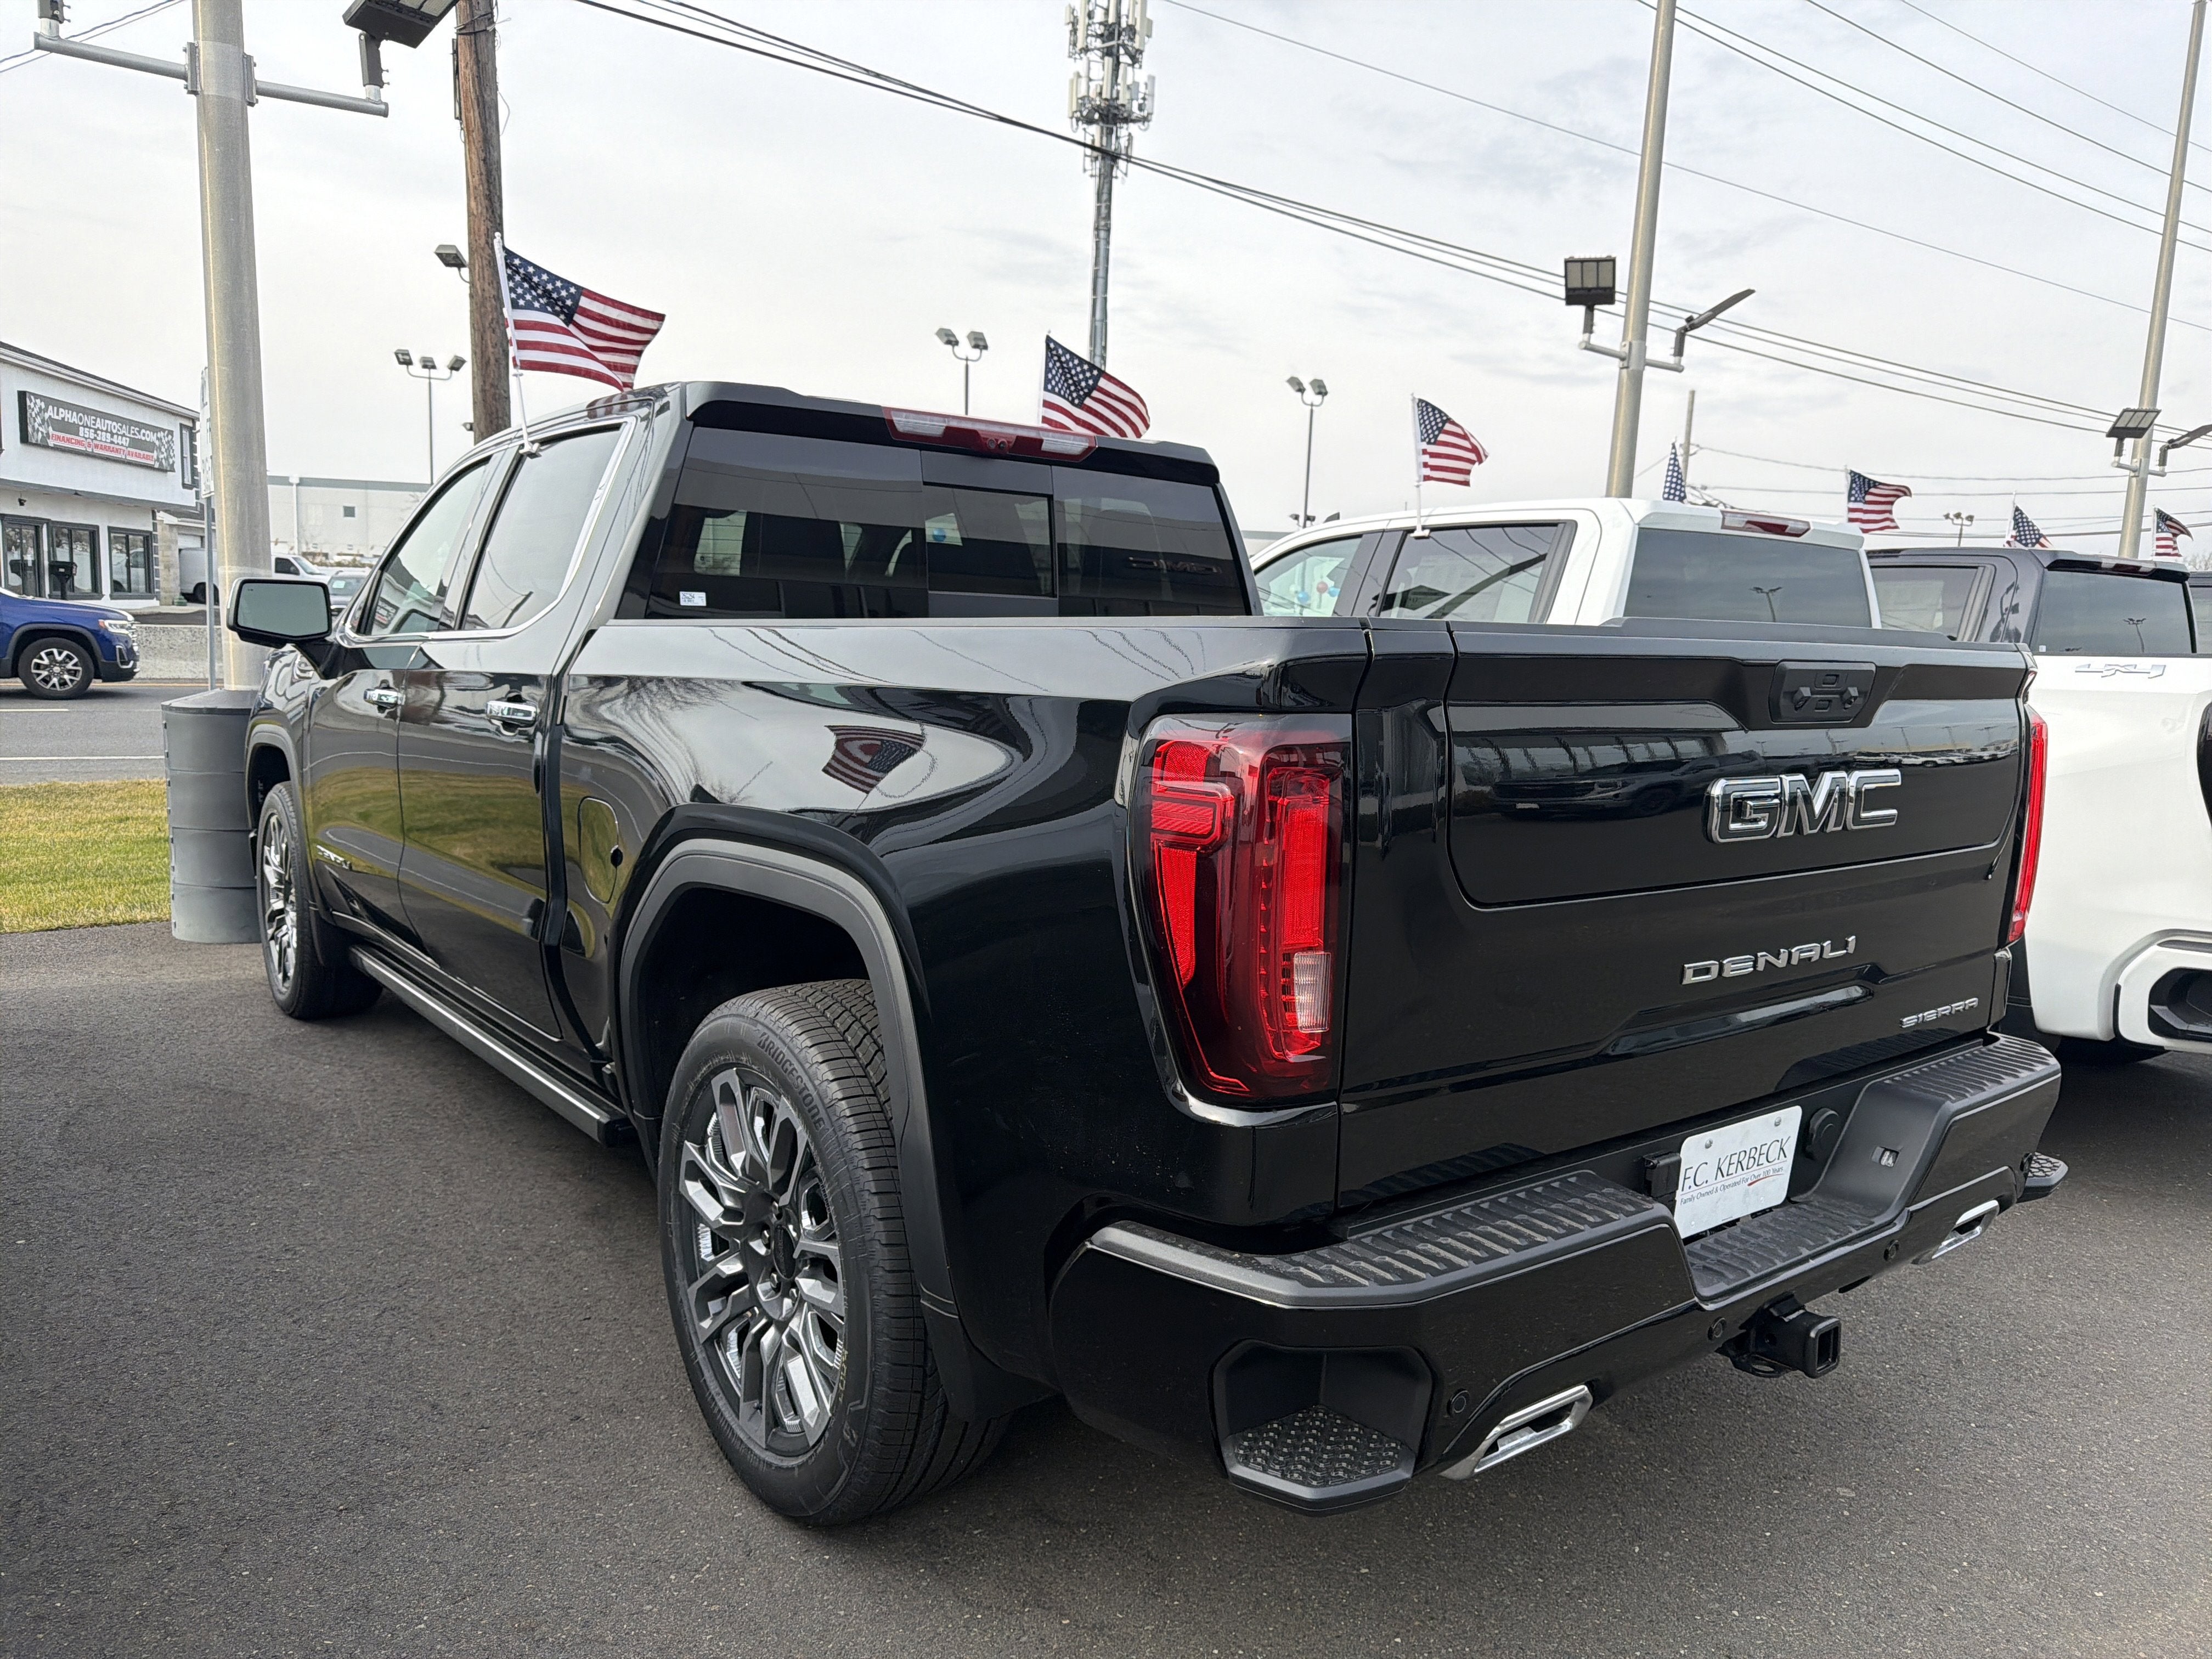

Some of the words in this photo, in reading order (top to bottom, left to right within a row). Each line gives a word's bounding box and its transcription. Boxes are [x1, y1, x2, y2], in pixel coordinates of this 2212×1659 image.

[47, 405, 157, 442] ALPHAONEAUTOSALES.COM
[79, 426, 129, 447] 856-389-4447
[51, 433, 85, 447] FINANCING
[94, 444, 126, 455] WARRANTY
[127, 449, 154, 461] AVAILABLE
[1704, 769, 1901, 844] GMC
[1681, 935, 1856, 984] DENALI
[1899, 997, 1978, 1028] SIERRA
[757, 1032, 825, 1131] BRIDGESTONE
[1681, 1162, 1708, 1192] F.C.
[1715, 1136, 1791, 1181] KERBECK
[1680, 1194, 1695, 1205] Family
[1696, 1187, 1714, 1199] Owned
[1714, 1184, 1718, 1193] &
[1720, 1179, 1741, 1192] Operated
[1741, 1177, 1750, 1186] For
[1750, 1173, 1762, 1181] Over
[1762, 1170, 1771, 1178] 100
[1772, 1166, 1784, 1175] Years
